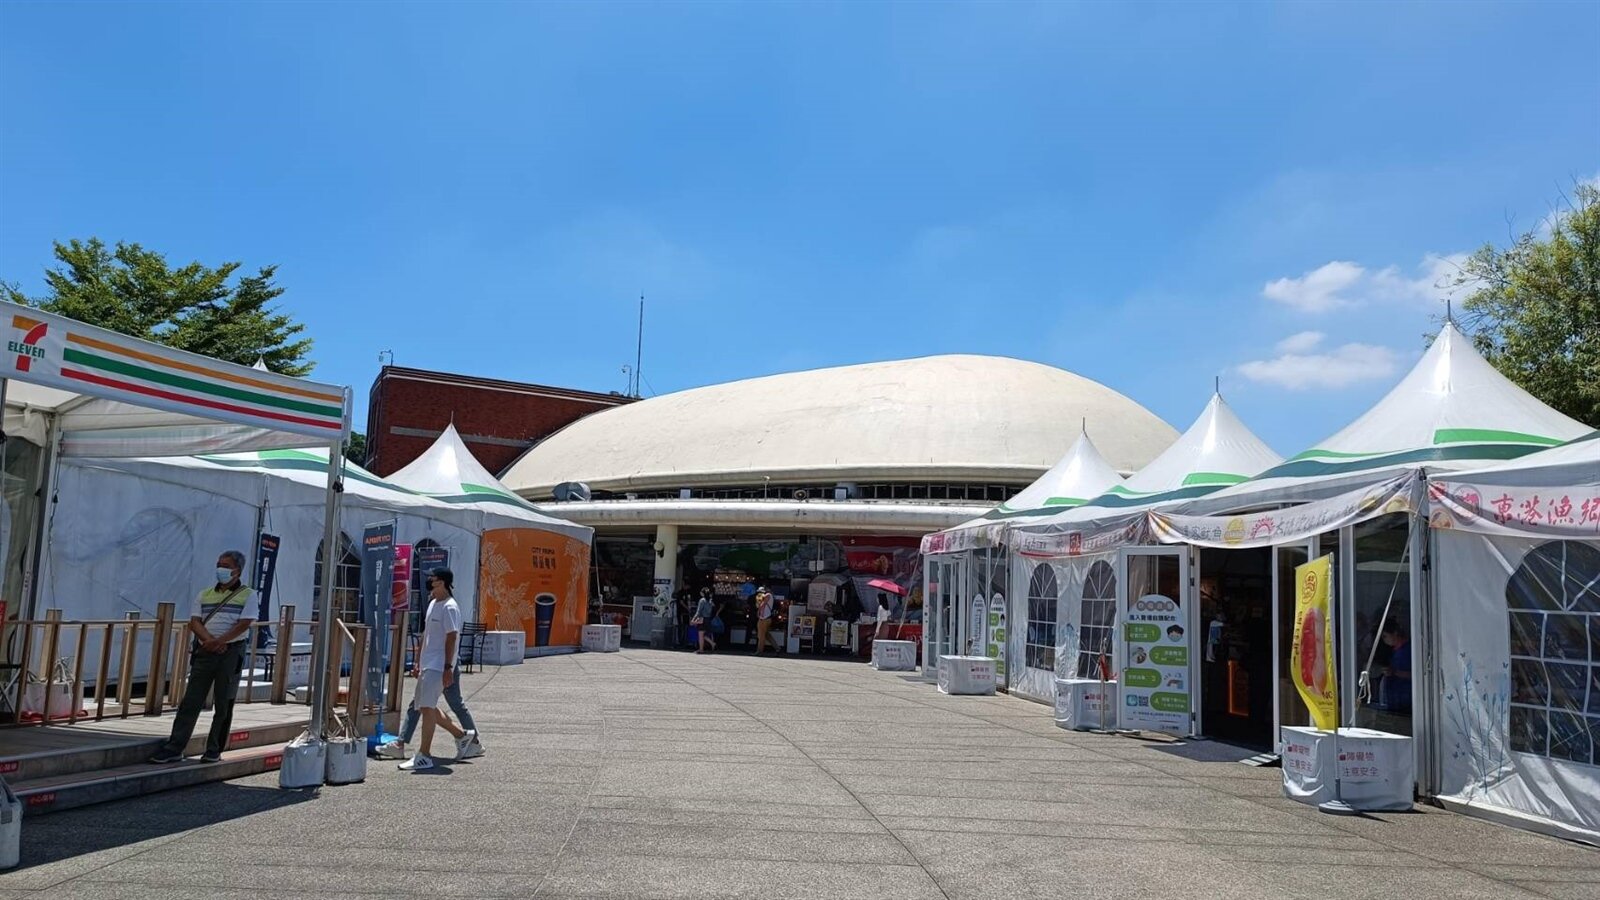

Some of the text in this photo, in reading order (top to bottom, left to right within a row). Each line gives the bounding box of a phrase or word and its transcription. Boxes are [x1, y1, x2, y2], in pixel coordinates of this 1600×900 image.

[8, 340, 45, 359] ELEVEN
[12, 315, 48, 372] 7
[1346, 751, 1375, 761] 障礙物
[1343, 766, 1379, 777] 注意安全
